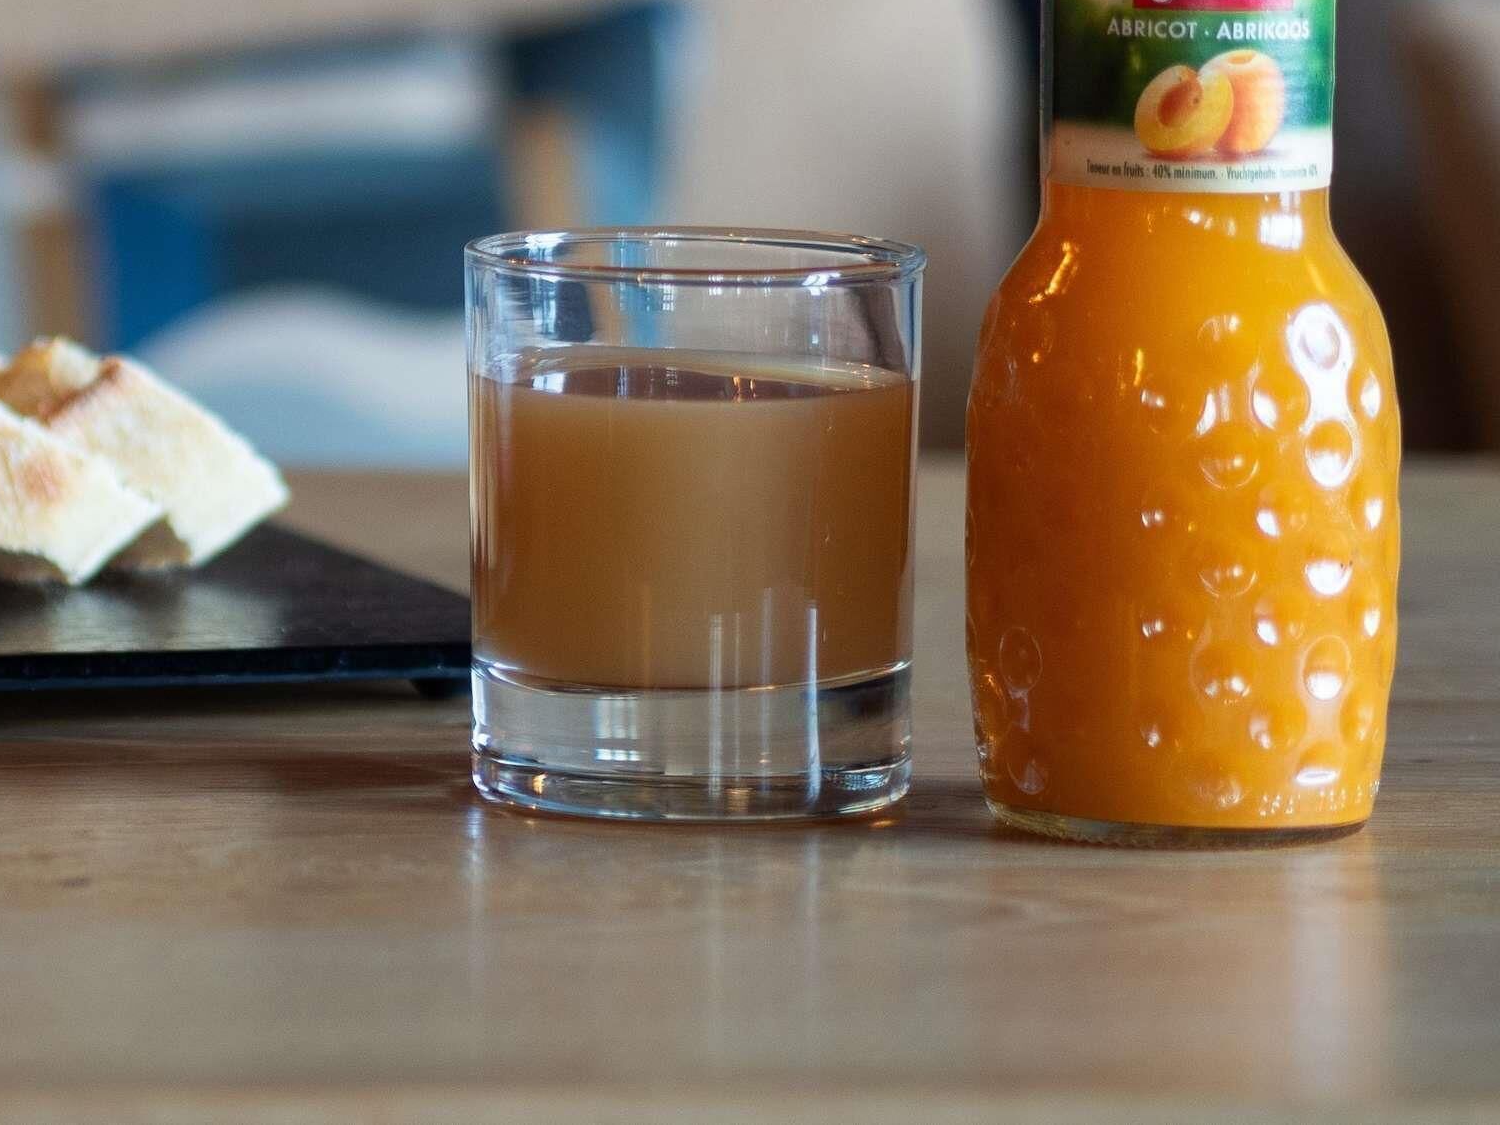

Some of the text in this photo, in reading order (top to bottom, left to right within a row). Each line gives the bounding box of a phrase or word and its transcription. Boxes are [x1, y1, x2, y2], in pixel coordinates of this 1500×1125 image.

[1106, 17, 1311, 40] ABRICOT ABRIKOOS
[1153, 163, 1171, 179] 40%
